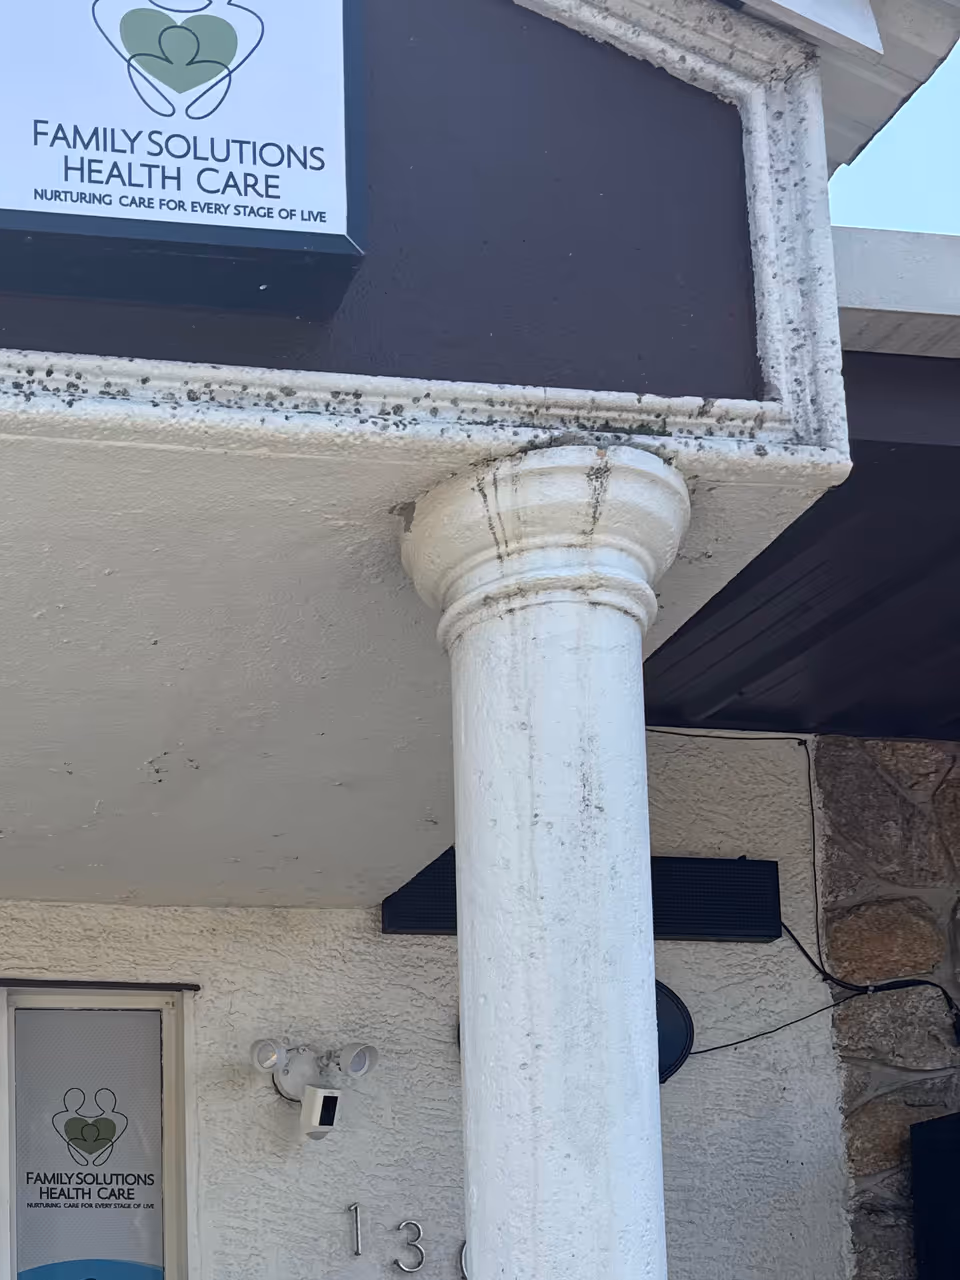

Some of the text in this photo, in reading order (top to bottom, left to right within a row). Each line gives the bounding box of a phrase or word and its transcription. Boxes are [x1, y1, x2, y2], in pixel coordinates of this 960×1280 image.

[64, 155, 281, 199] HEALTH CARE
[33, 189, 327, 223] NURTURING CARE FOR EVERY STAGE OF LIVE
[39, 1187, 135, 1200] HEALTH CARE
[348, 1203, 468, 1280] 13
